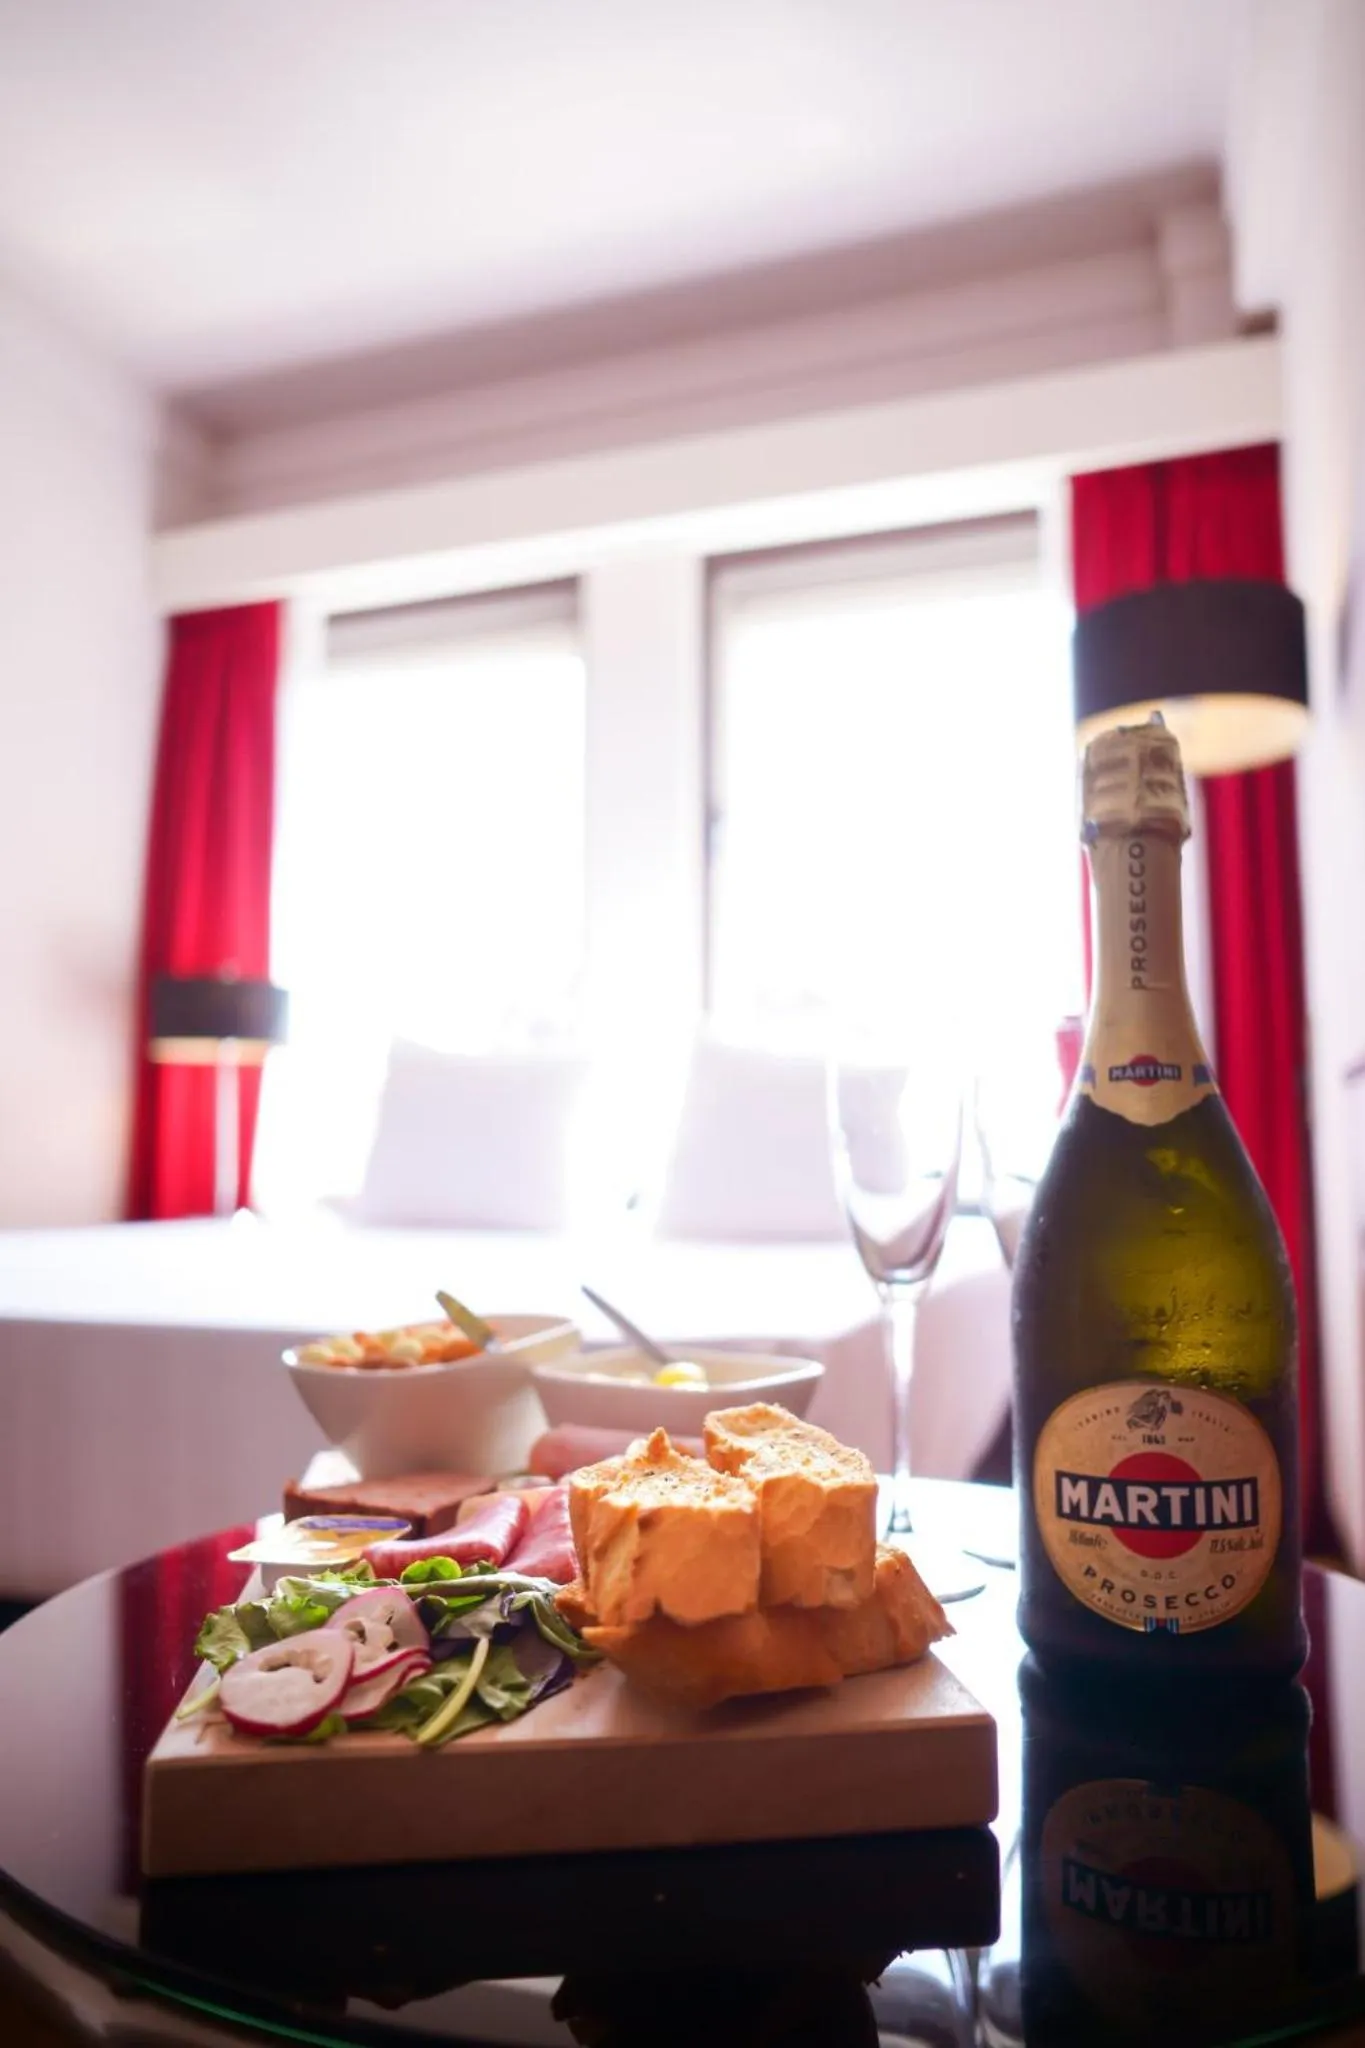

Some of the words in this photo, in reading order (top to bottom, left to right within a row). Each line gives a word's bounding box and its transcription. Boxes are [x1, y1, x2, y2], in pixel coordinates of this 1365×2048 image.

[1128, 841, 1147, 990] PROSECCO
[1110, 1063, 1179, 1080] MARTINI
[1060, 1476, 1253, 1526] MARTINI
[1083, 1565, 1236, 1610] PROSECCO
